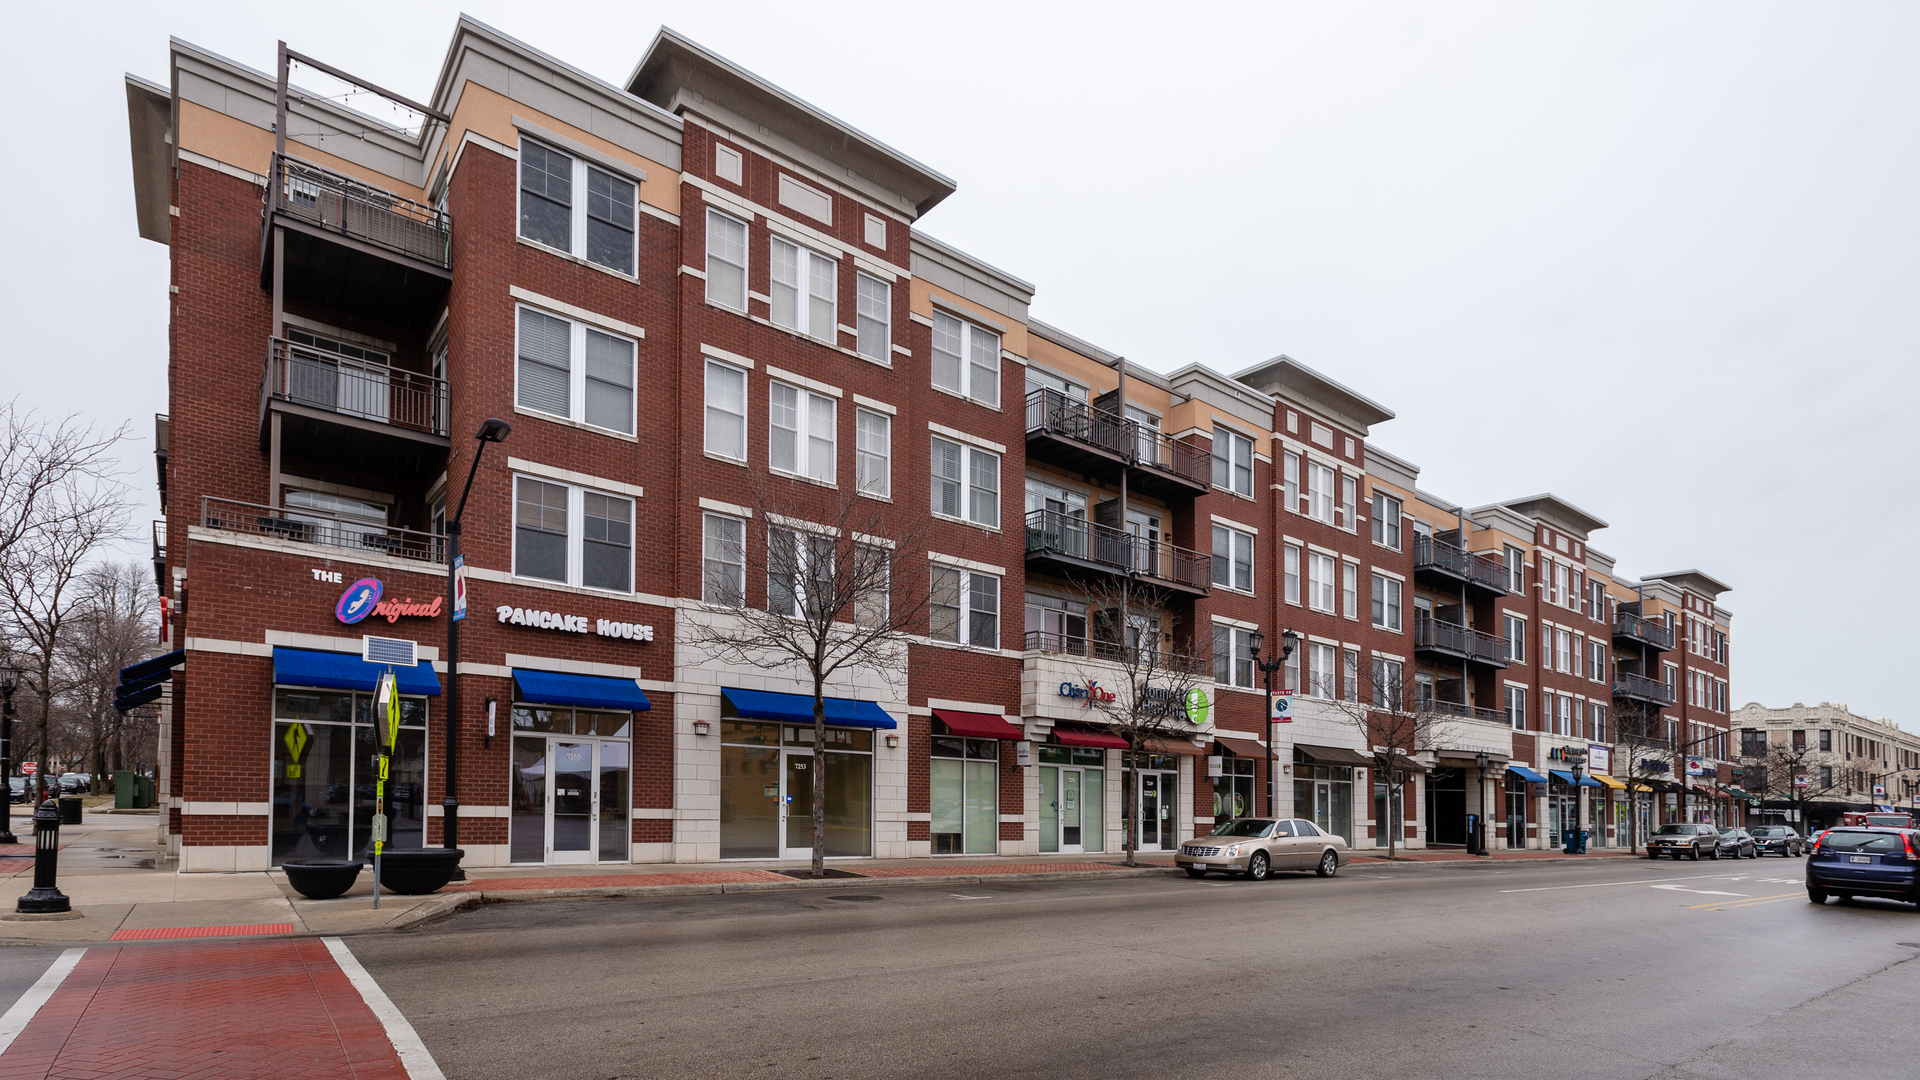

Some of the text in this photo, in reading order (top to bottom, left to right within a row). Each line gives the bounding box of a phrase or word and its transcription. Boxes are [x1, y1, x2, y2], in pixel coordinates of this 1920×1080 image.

[311, 569, 342, 584] THE
[496, 605, 654, 642] PANCAKE HOUSE
[1094, 686, 1116, 703] One
